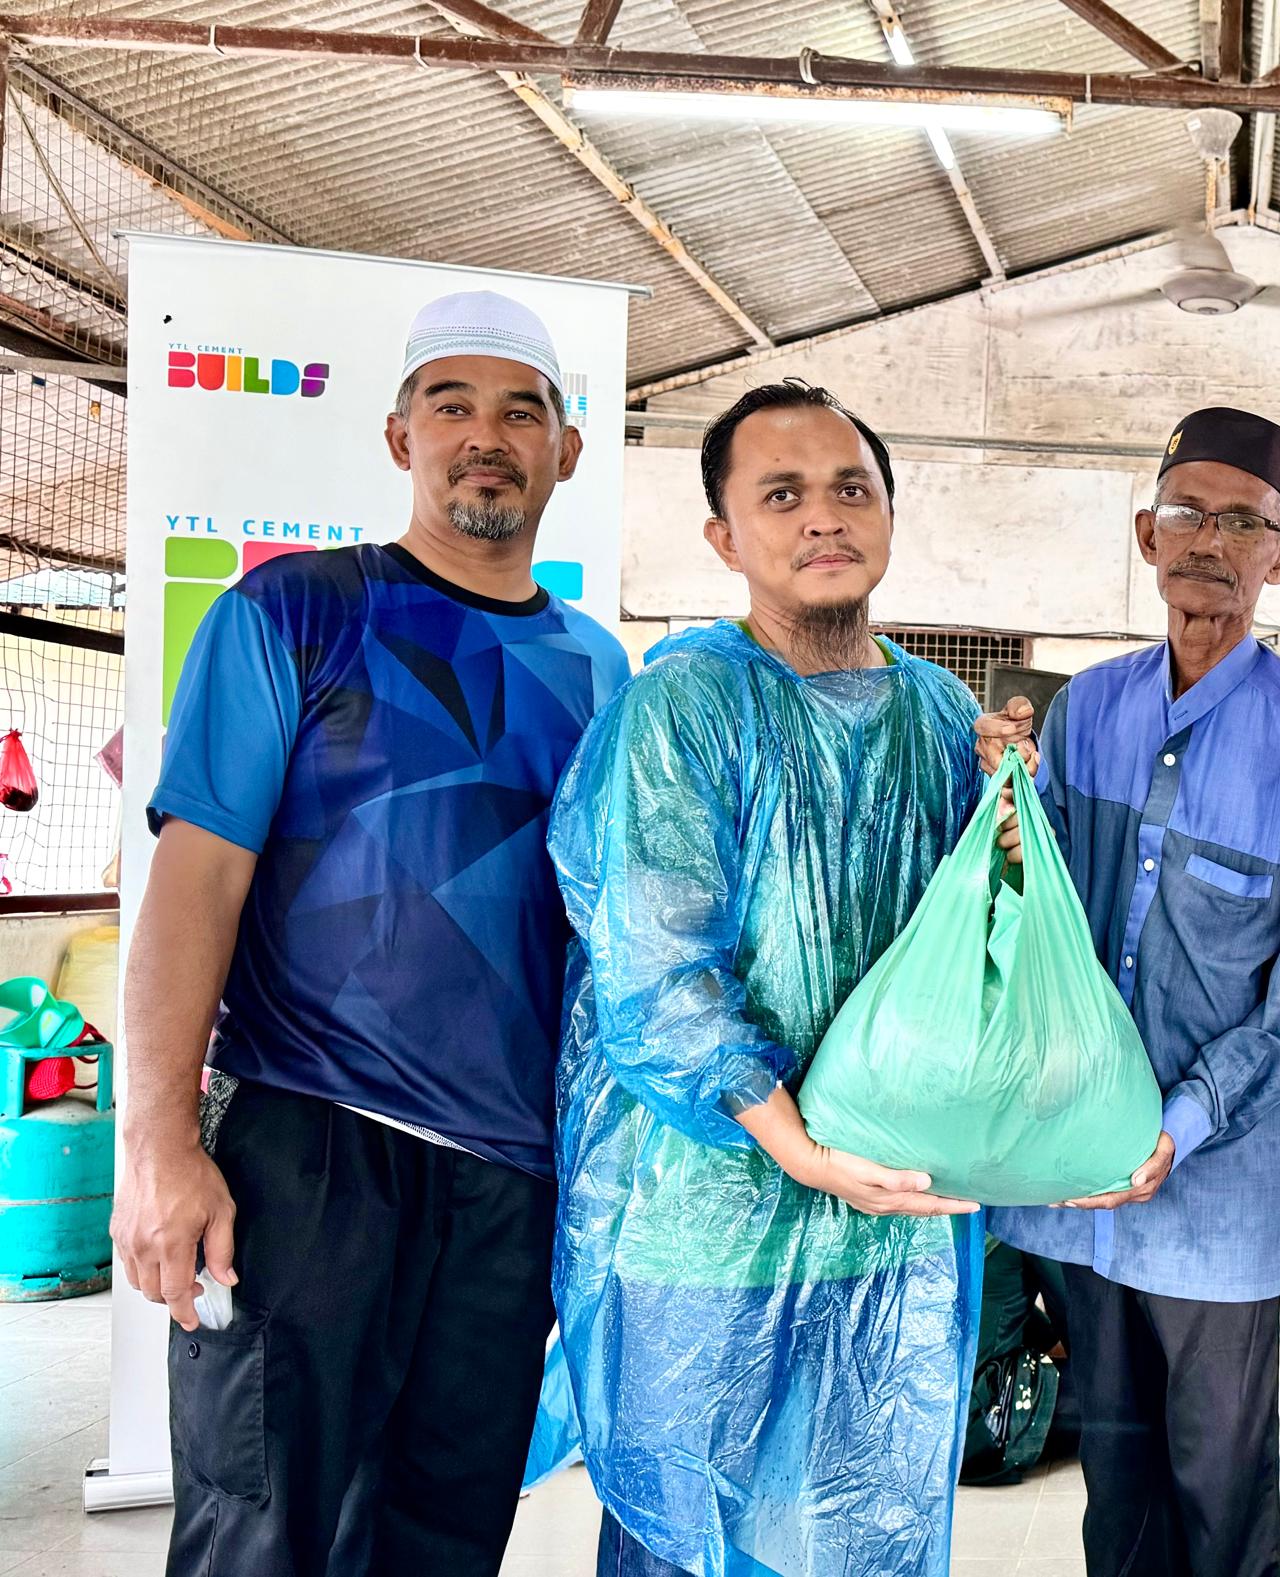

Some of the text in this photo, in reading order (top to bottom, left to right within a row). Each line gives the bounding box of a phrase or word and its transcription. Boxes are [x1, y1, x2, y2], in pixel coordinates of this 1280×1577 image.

[168, 342, 243, 355] YTL CEMENT
[168, 351, 330, 398] BUILDS
[166, 515, 364, 542] YTL CEMENT
